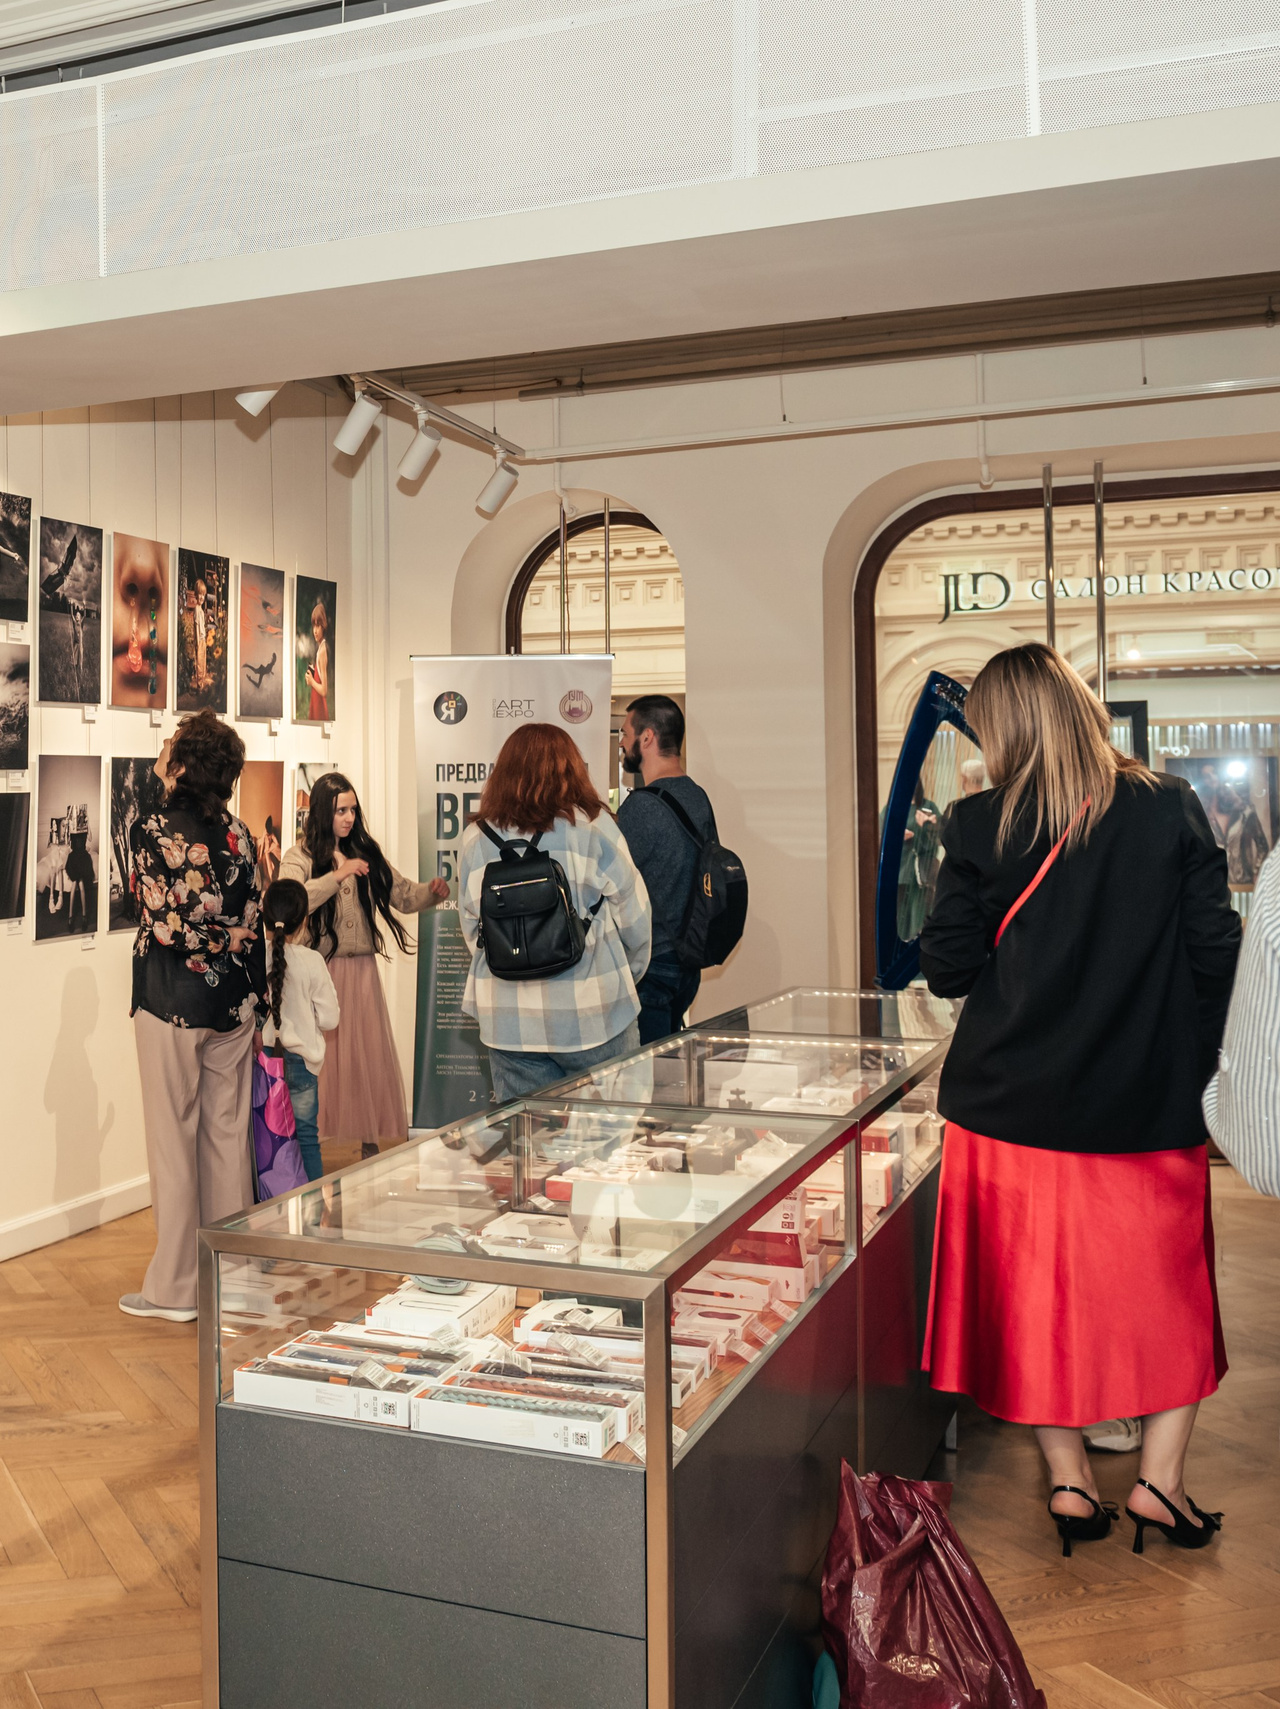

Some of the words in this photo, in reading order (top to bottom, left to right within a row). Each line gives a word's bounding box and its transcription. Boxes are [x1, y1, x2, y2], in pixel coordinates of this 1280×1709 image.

[1031, 574, 1145, 600] САЛОН
[1162, 567, 1280, 594] КРАСО
[568, 689, 584, 701] ГУМ
[497, 699, 535, 710] ART
[496, 710, 535, 718] EXPO
[469, 1090, 477, 1102] 2
